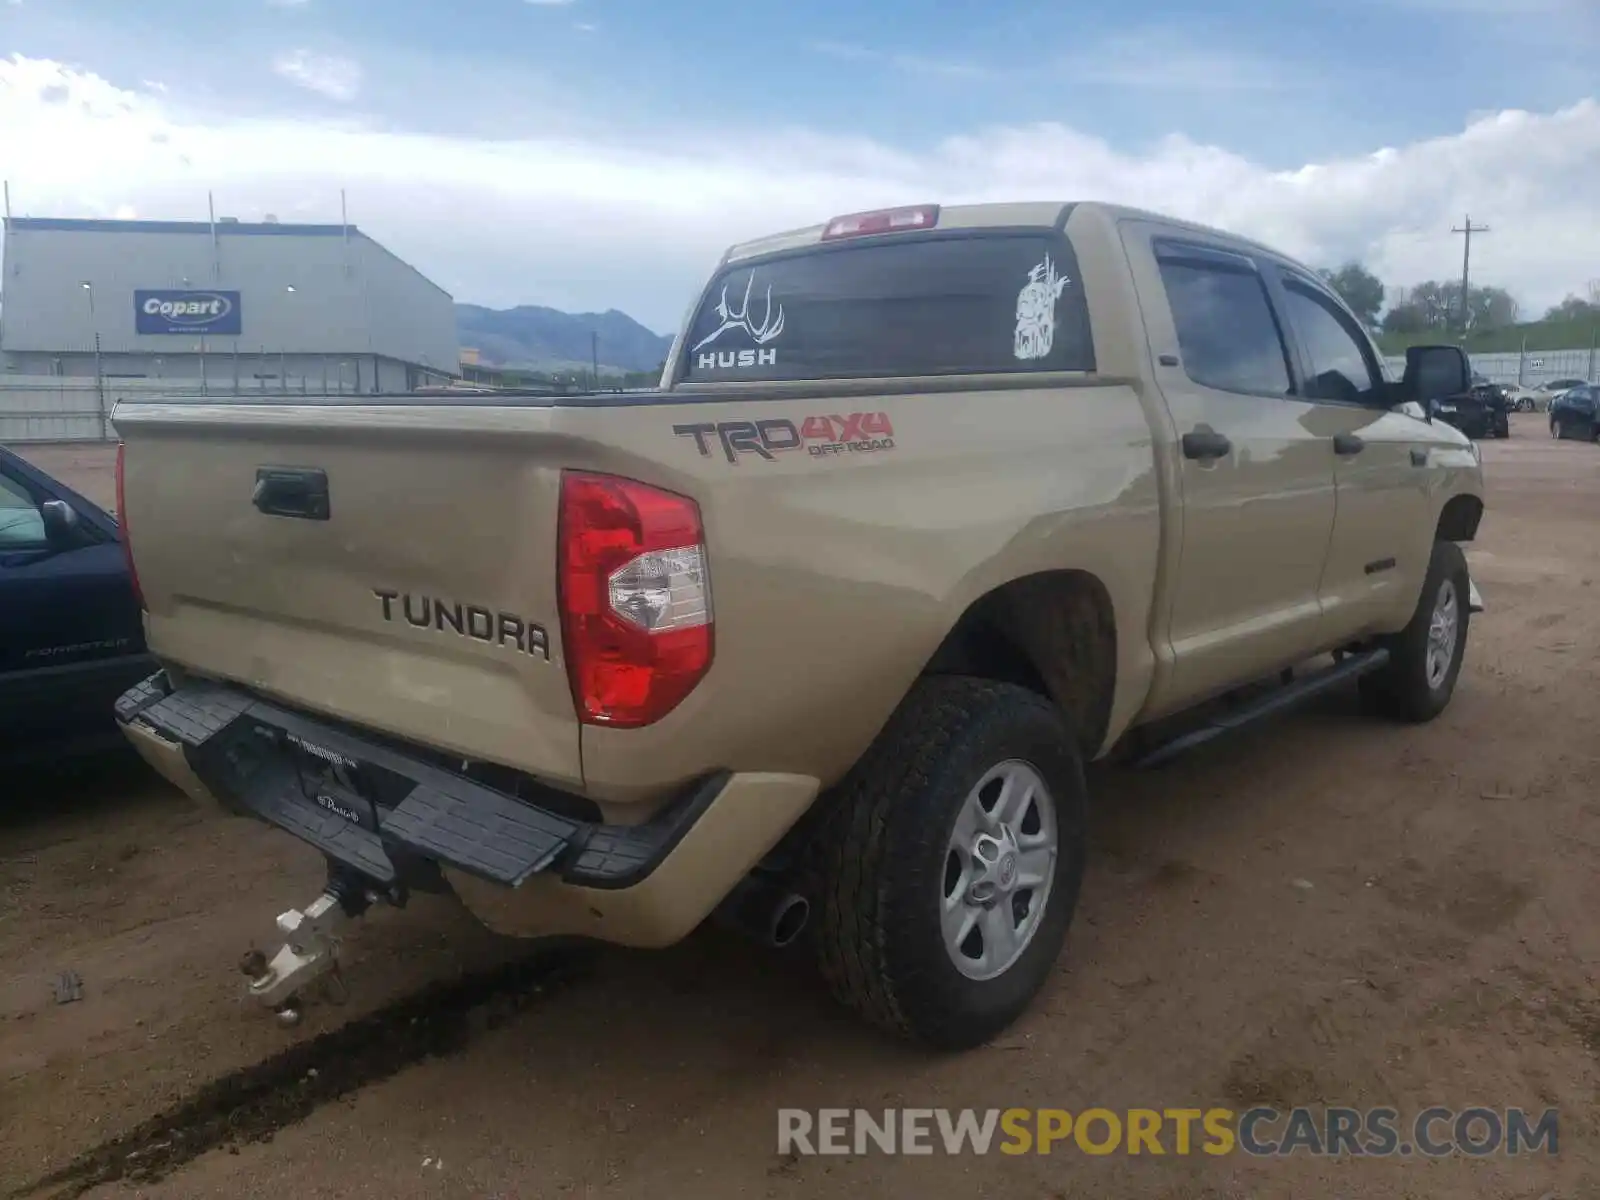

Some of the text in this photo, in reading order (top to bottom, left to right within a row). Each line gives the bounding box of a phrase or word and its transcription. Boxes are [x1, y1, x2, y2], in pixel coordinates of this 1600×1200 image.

[144, 298, 221, 318] Copart
[698, 348, 777, 369] HUSH
[672, 418, 803, 465] TRD
[808, 438, 895, 456] OFF ROAD
[371, 587, 550, 664] TUNDRA
